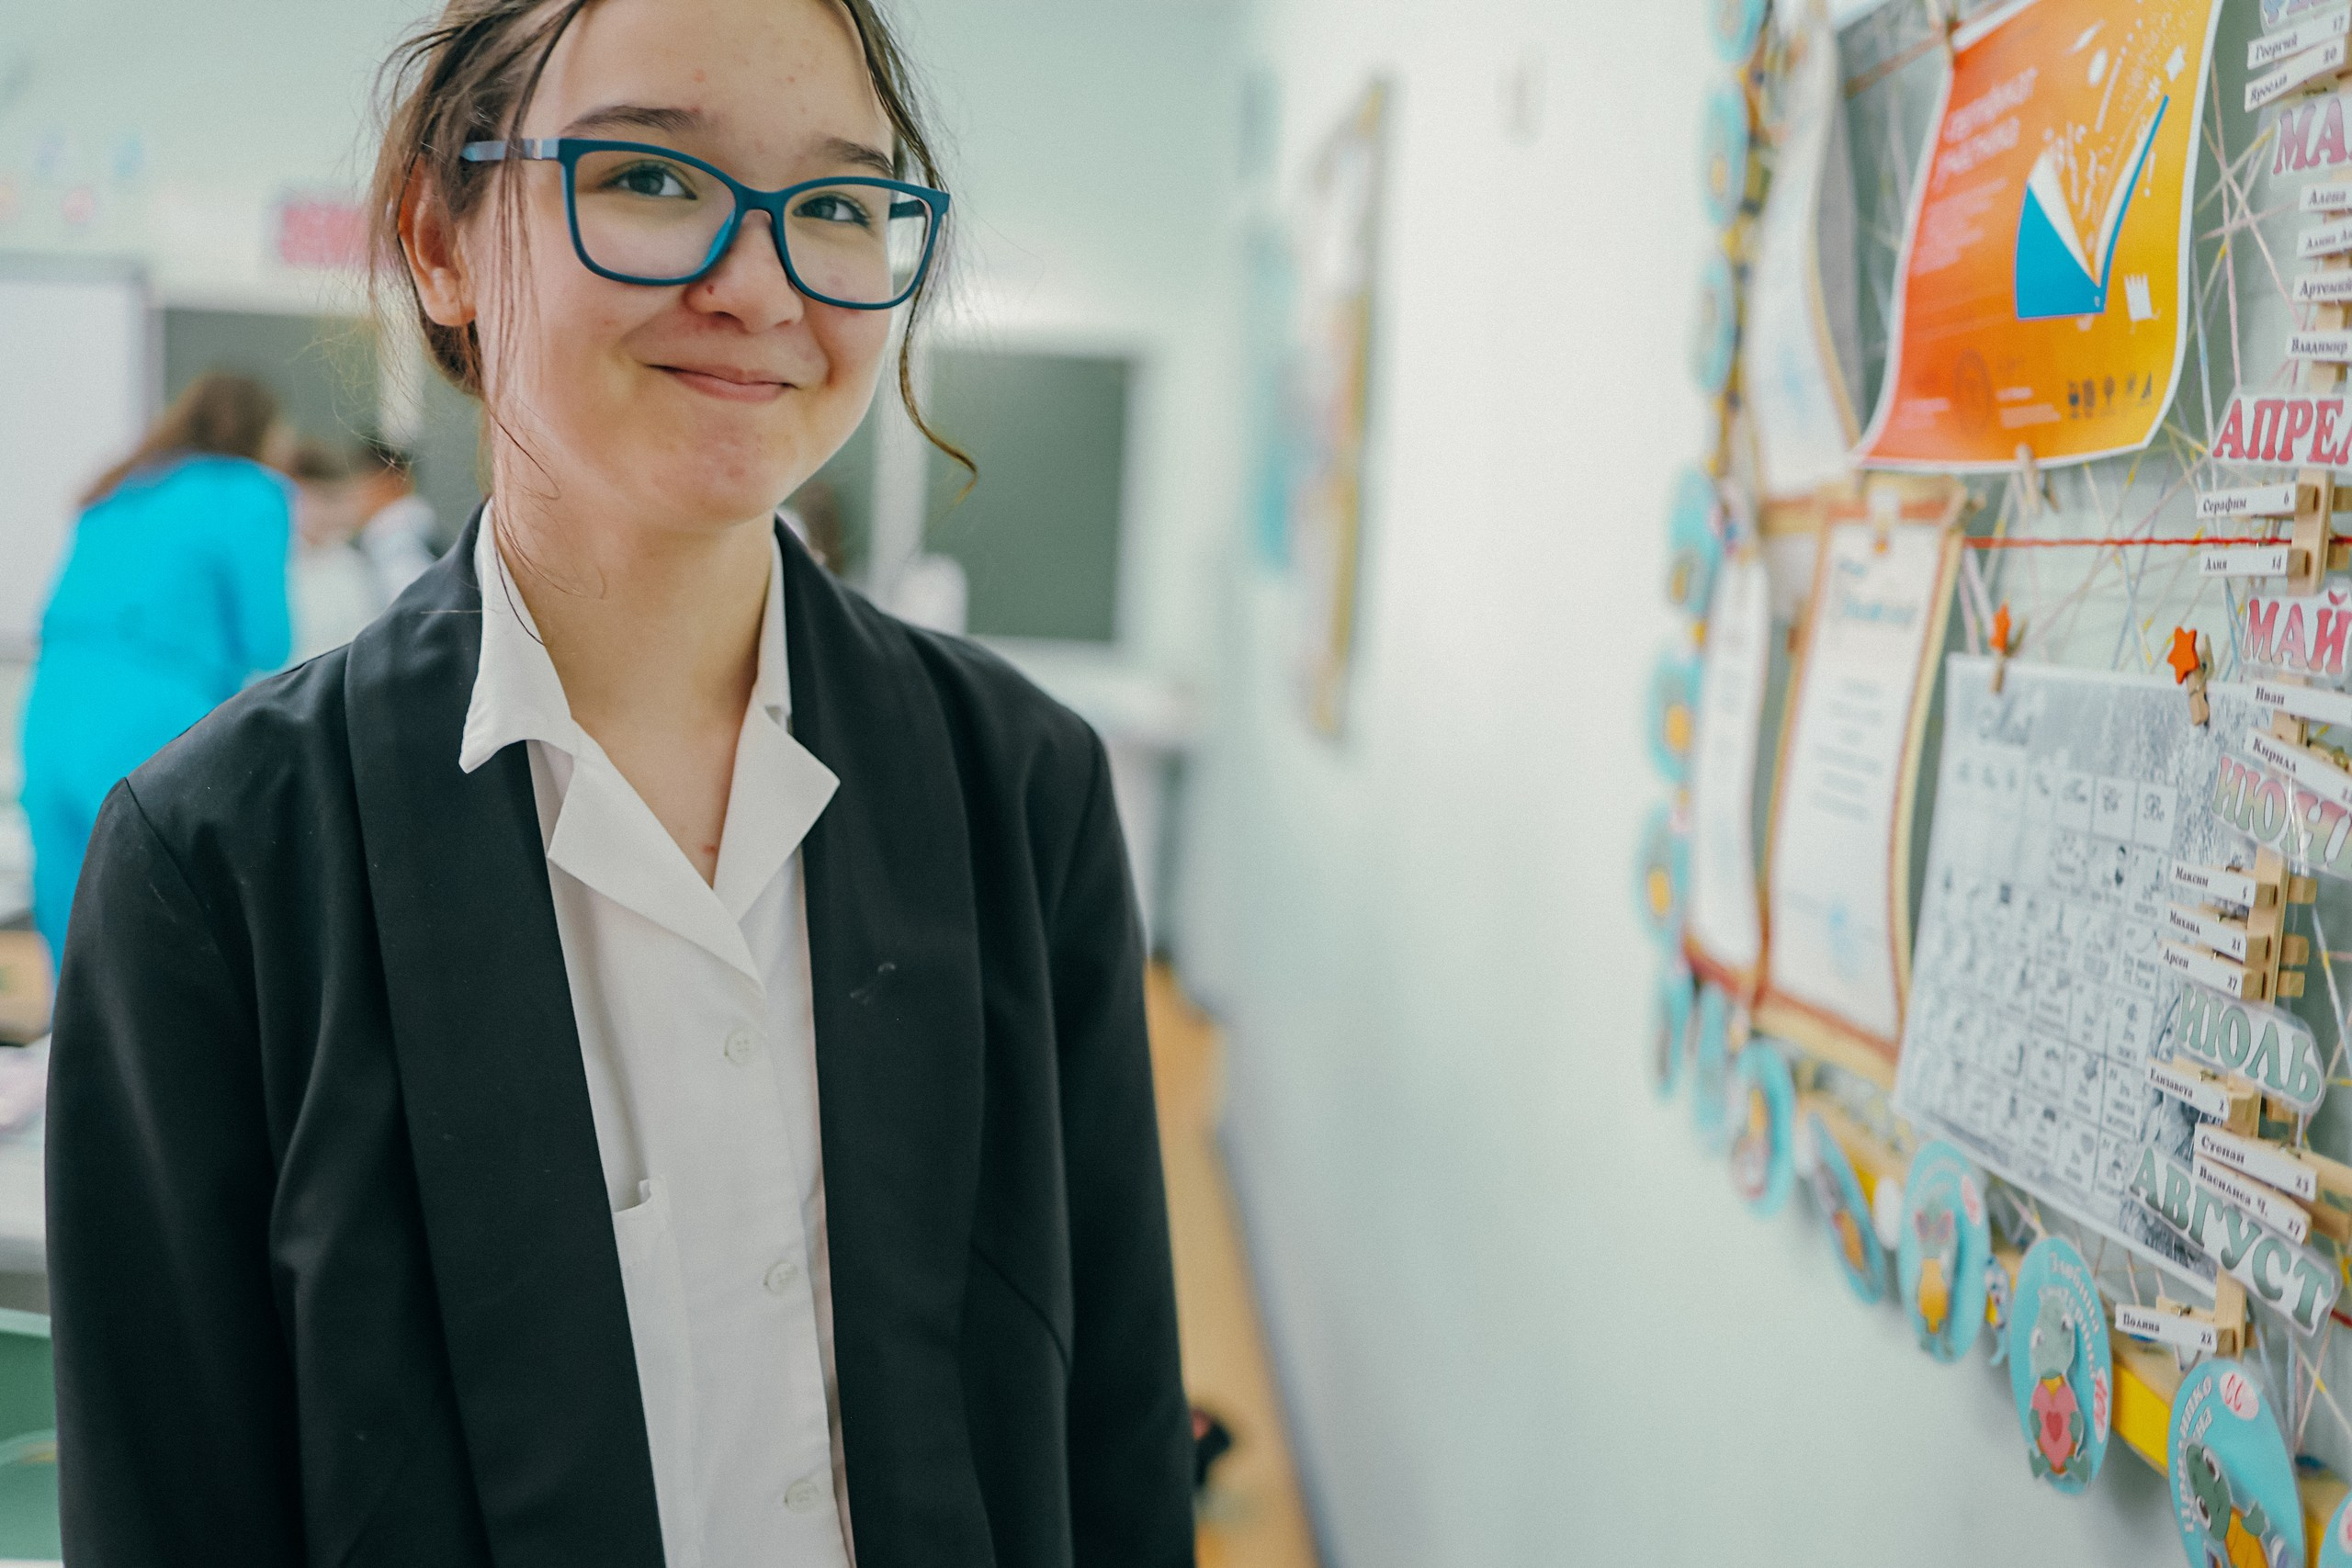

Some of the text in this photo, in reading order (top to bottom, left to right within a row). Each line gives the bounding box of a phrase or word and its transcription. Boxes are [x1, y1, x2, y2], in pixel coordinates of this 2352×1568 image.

[2273, 97, 2352, 175] МА
[2291, 337, 2347, 356] Владимир
[2242, 589, 2352, 674] МАЙ
[2255, 686, 2285, 705] Иван
[2253, 738, 2297, 773] Кирилл
[2175, 866, 2209, 887] Максим
[2169, 910, 2200, 936] Михаил
[2164, 949, 2189, 970] Арсен
[2177, 983, 2320, 1102] ИЮЛЬ
[2151, 1067, 2193, 1099] Елизавета
[2201, 1134, 2245, 1164] Степан
[2199, 1165, 2252, 1206] Василиса
[2130, 1147, 2332, 1330] АВГУСТ
[2123, 1313, 2160, 1332] Полина
